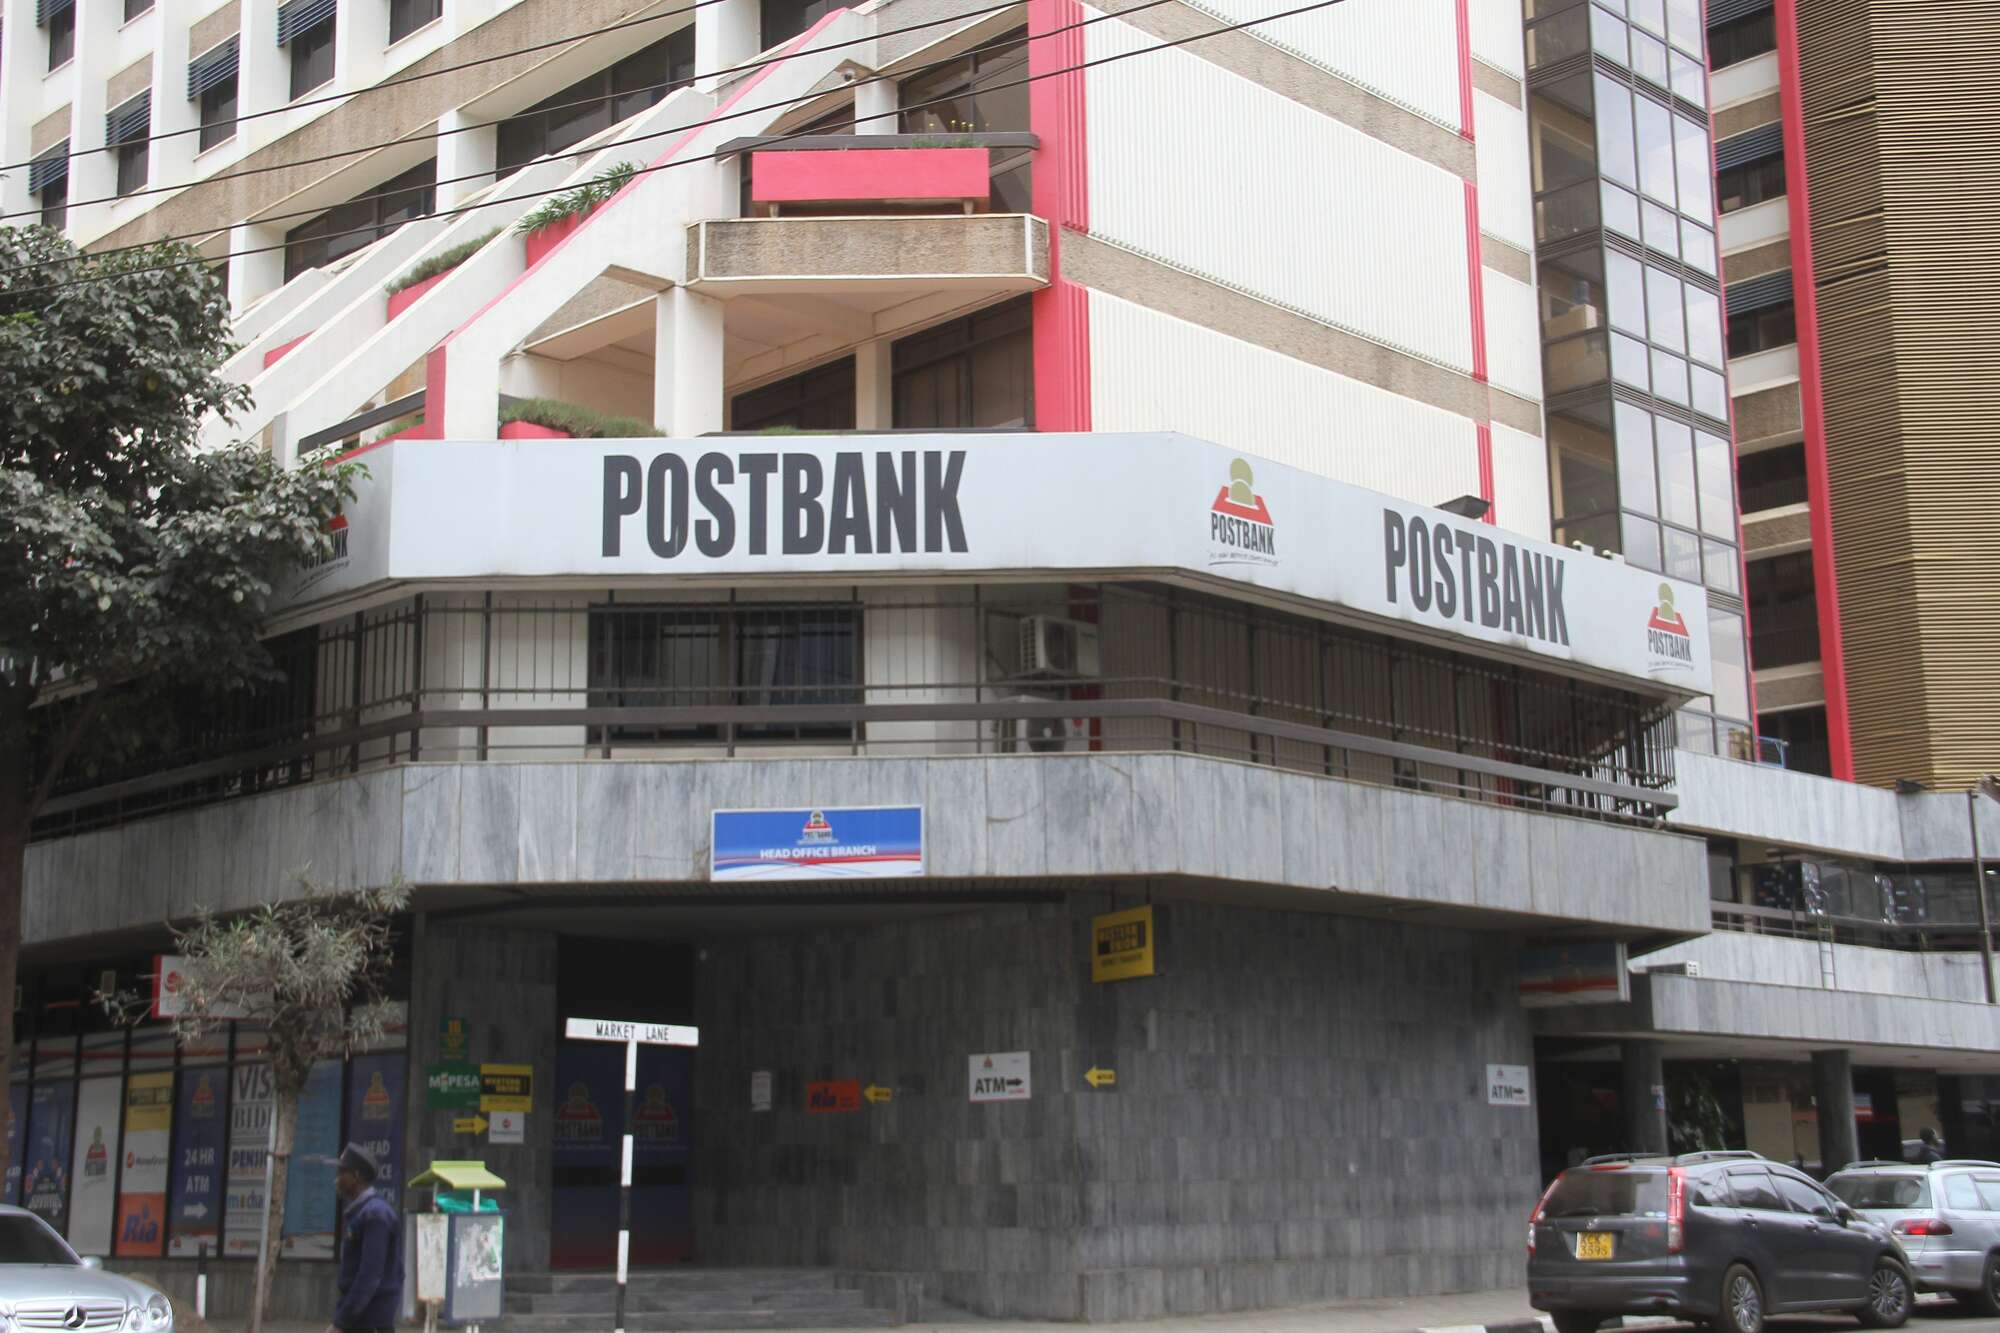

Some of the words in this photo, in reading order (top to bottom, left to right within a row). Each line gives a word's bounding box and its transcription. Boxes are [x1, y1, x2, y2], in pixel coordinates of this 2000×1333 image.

[603, 451, 968, 558] POSTBANK
[1211, 512, 1276, 556] POSTBANK
[1384, 509, 1570, 647] POSTBANK
[1648, 629, 1692, 662] POSTBANK
[760, 848, 790, 859] HEAD
[792, 846, 828, 858] OFFICE
[831, 845, 876, 857] BRANCH
[596, 1022, 635, 1039] MARKET
[646, 1027, 670, 1041] LANE
[975, 1077, 1006, 1094] ATM
[1491, 1085, 1513, 1099] ATM
[184, 1149, 199, 1167] 24
[201, 1147, 216, 1165] HR
[186, 1175, 210, 1194] ATM
[123, 1201, 159, 1243] Ria
